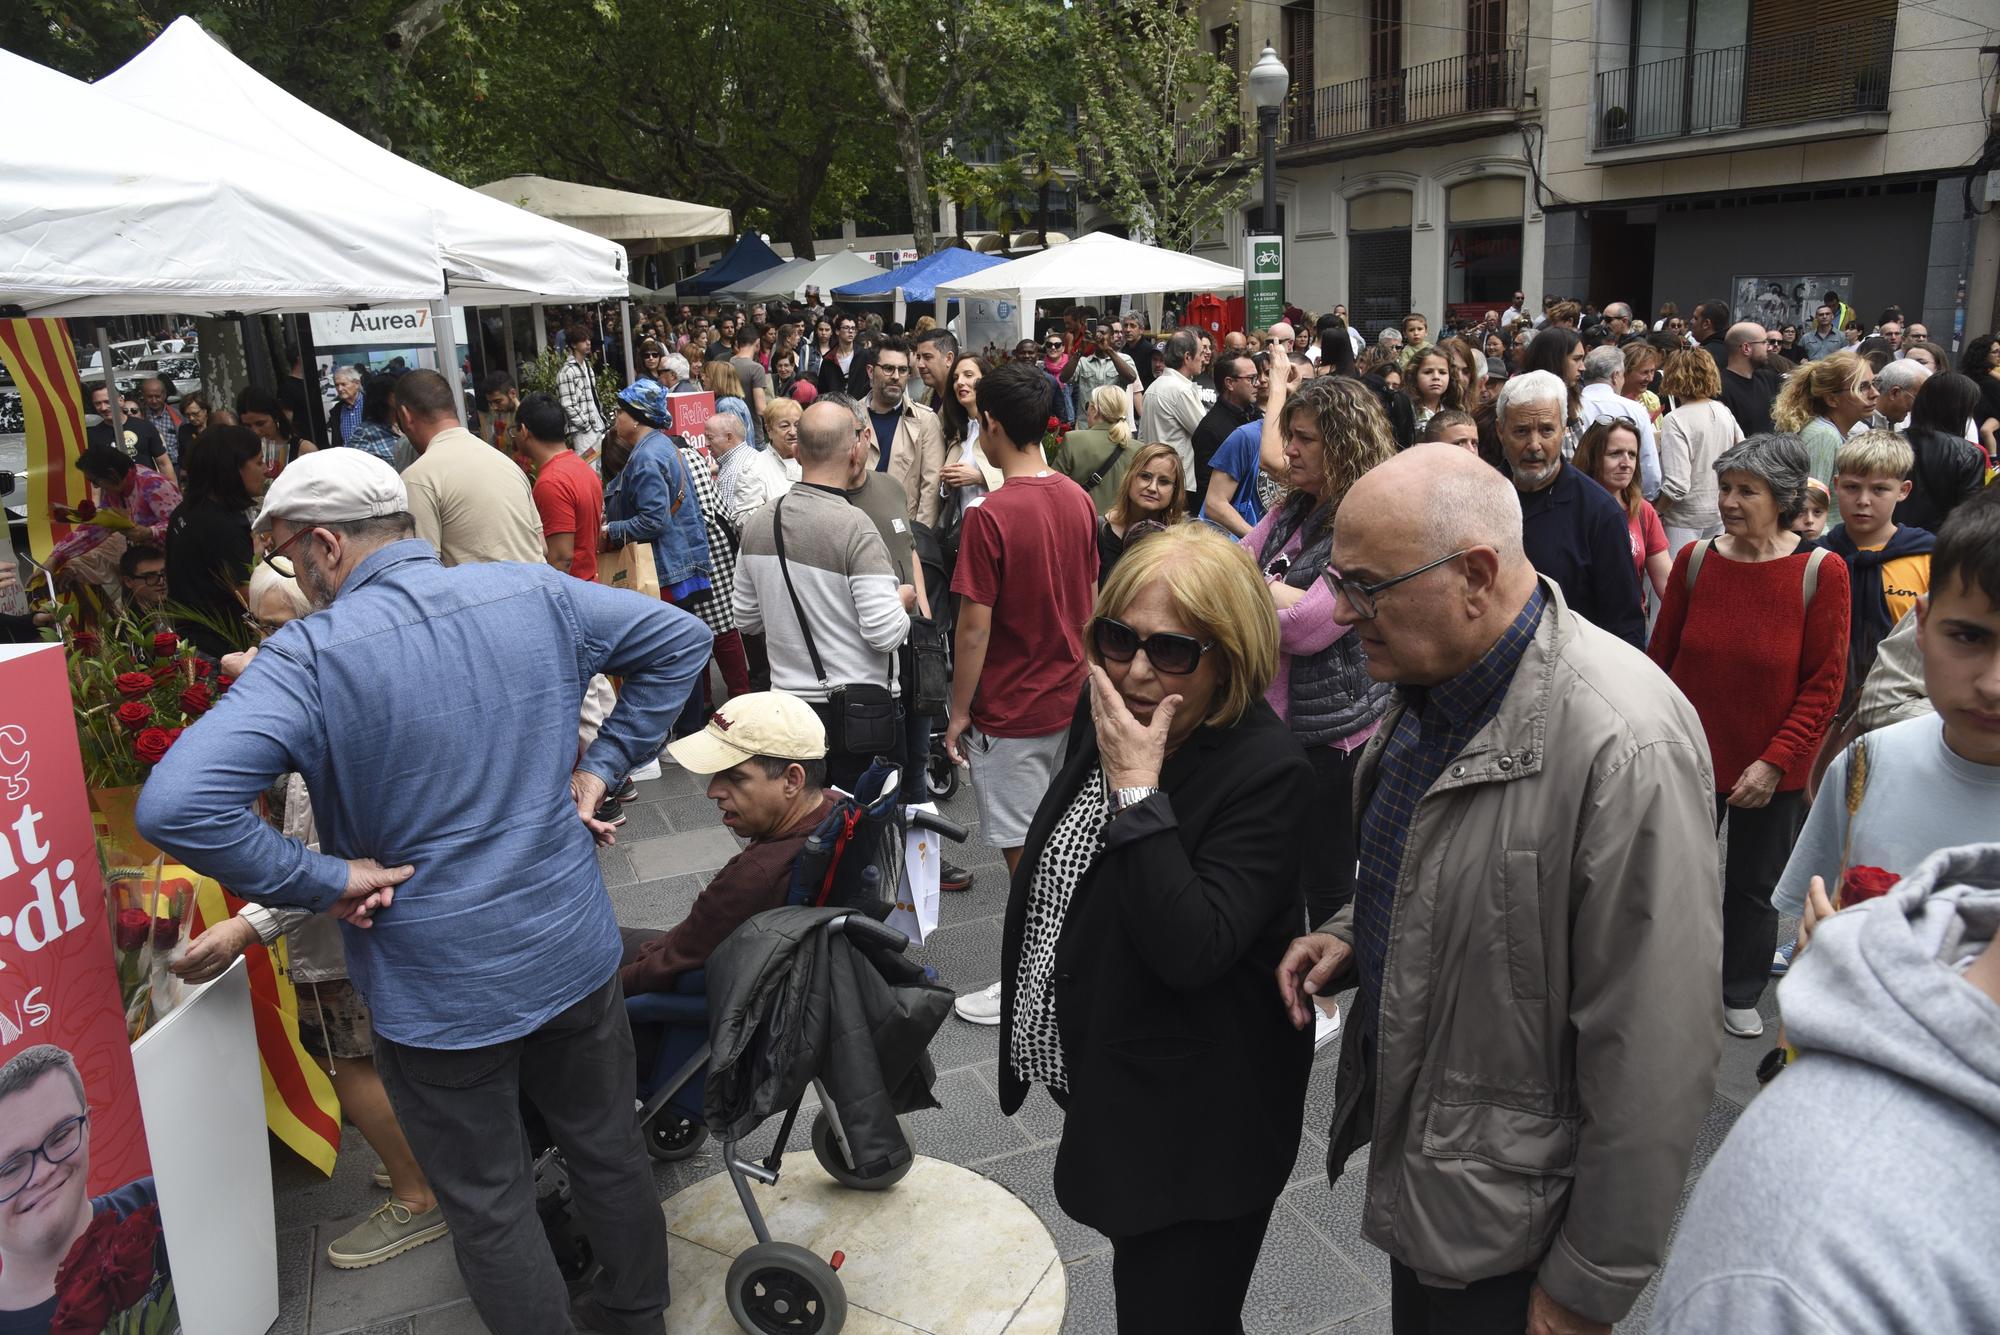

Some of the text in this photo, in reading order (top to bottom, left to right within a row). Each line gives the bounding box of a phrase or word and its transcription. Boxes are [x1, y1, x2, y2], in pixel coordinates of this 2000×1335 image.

[903, 252, 918, 260] Reg
[350, 309, 428, 333] Aurea7
[682, 430, 706, 449] San
[1884, 585, 1917, 597] ion
